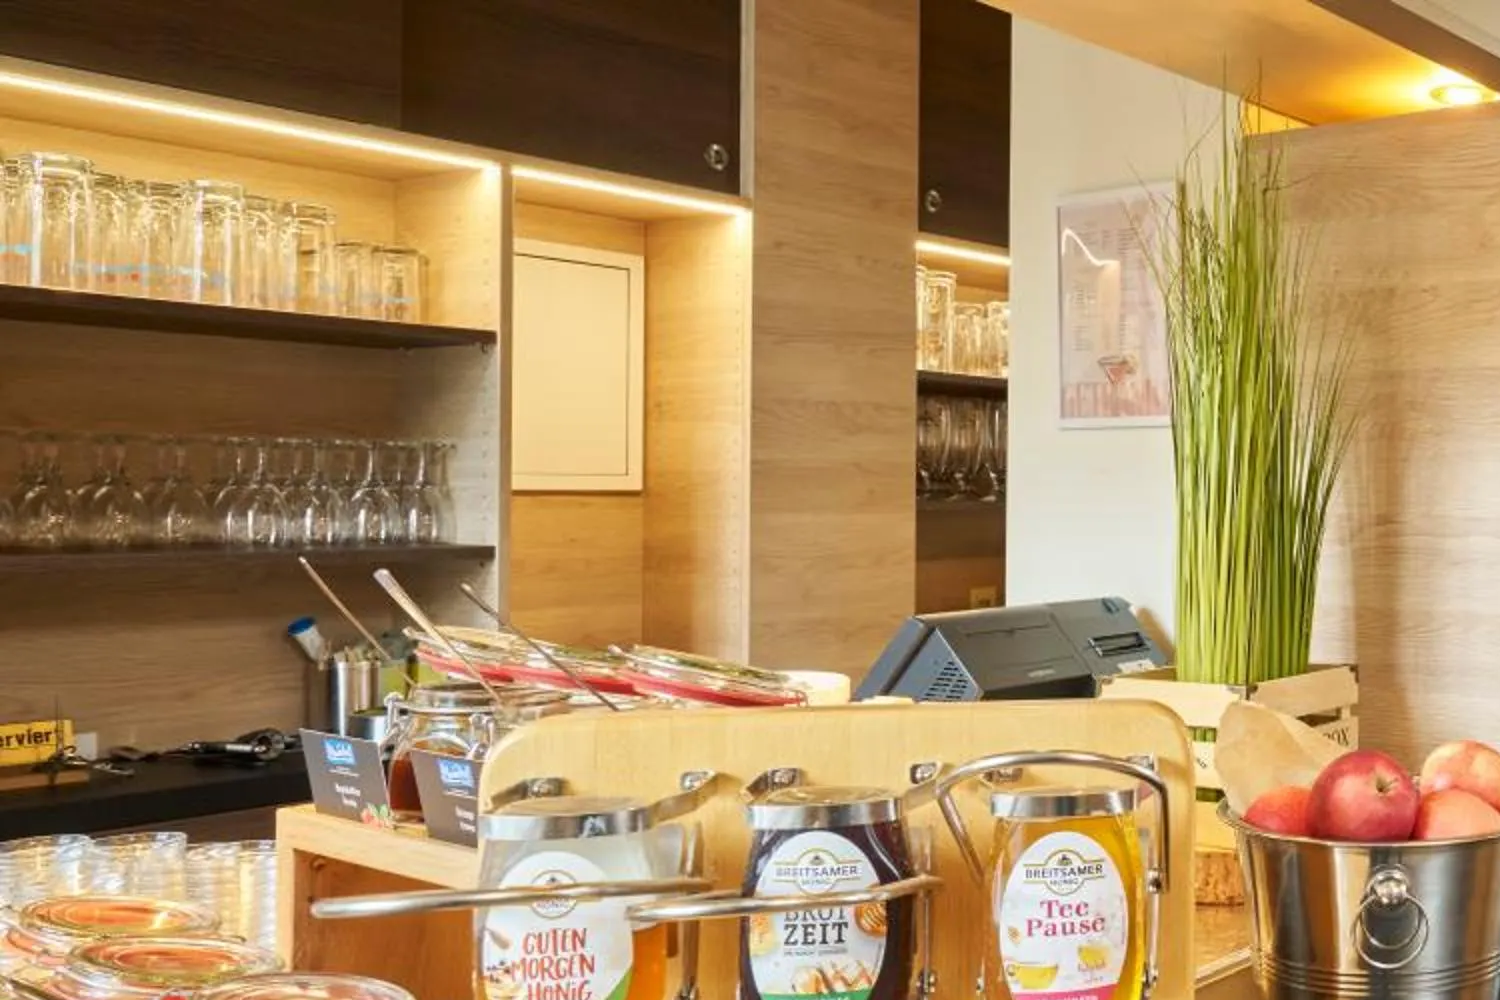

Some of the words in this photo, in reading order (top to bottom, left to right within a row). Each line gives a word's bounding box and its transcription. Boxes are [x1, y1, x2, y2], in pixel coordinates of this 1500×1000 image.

[776, 865, 858, 877] BREITSAMER
[1025, 864, 1104, 879] BREITSAMER
[1039, 899, 1089, 919] Tee
[783, 921, 849, 946] ZEIT
[1026, 916, 1106, 938] Pause
[522, 927, 587, 957] GUTEN
[511, 953, 595, 982] MORGEN
